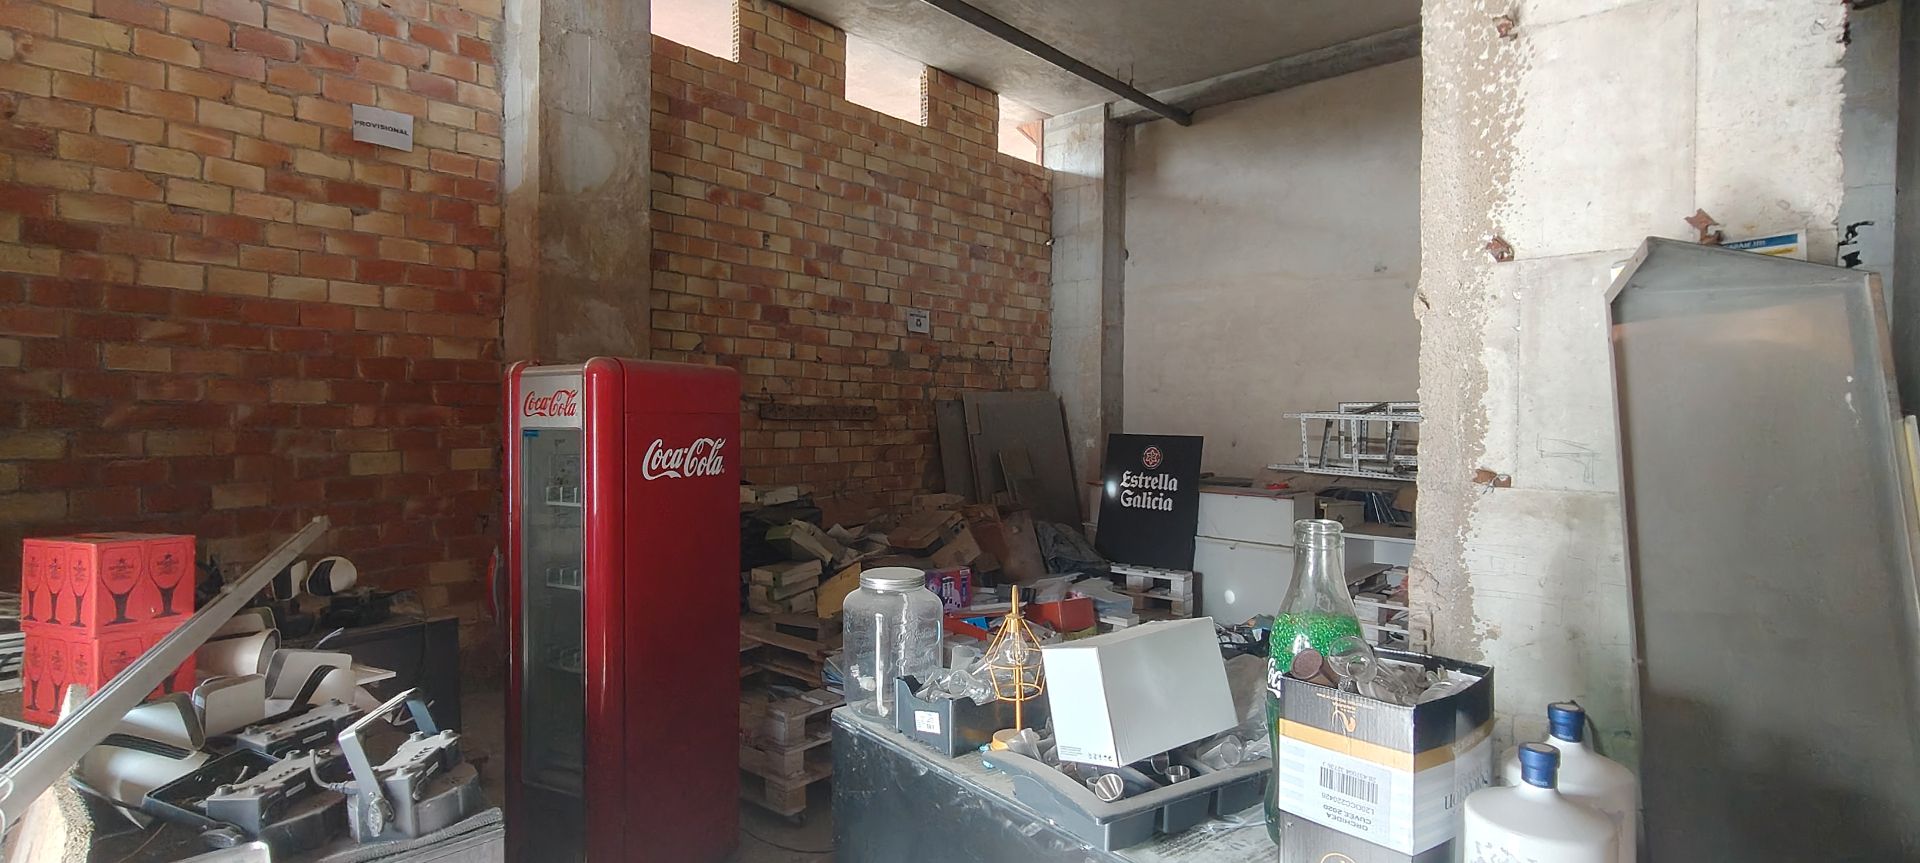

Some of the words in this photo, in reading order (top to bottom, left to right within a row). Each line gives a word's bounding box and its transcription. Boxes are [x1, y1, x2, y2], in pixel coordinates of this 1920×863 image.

[353, 120, 409, 136] PROVISIONAL
[523, 389, 578, 417] Coca-Cola
[642, 438, 726, 480] Coca-Cola
[1120, 470, 1178, 491] Estrella
[1120, 489, 1173, 511] Galicia
[1323, 803, 1343, 815] 2020
[1326, 812, 1368, 832] ORCHIDEA
